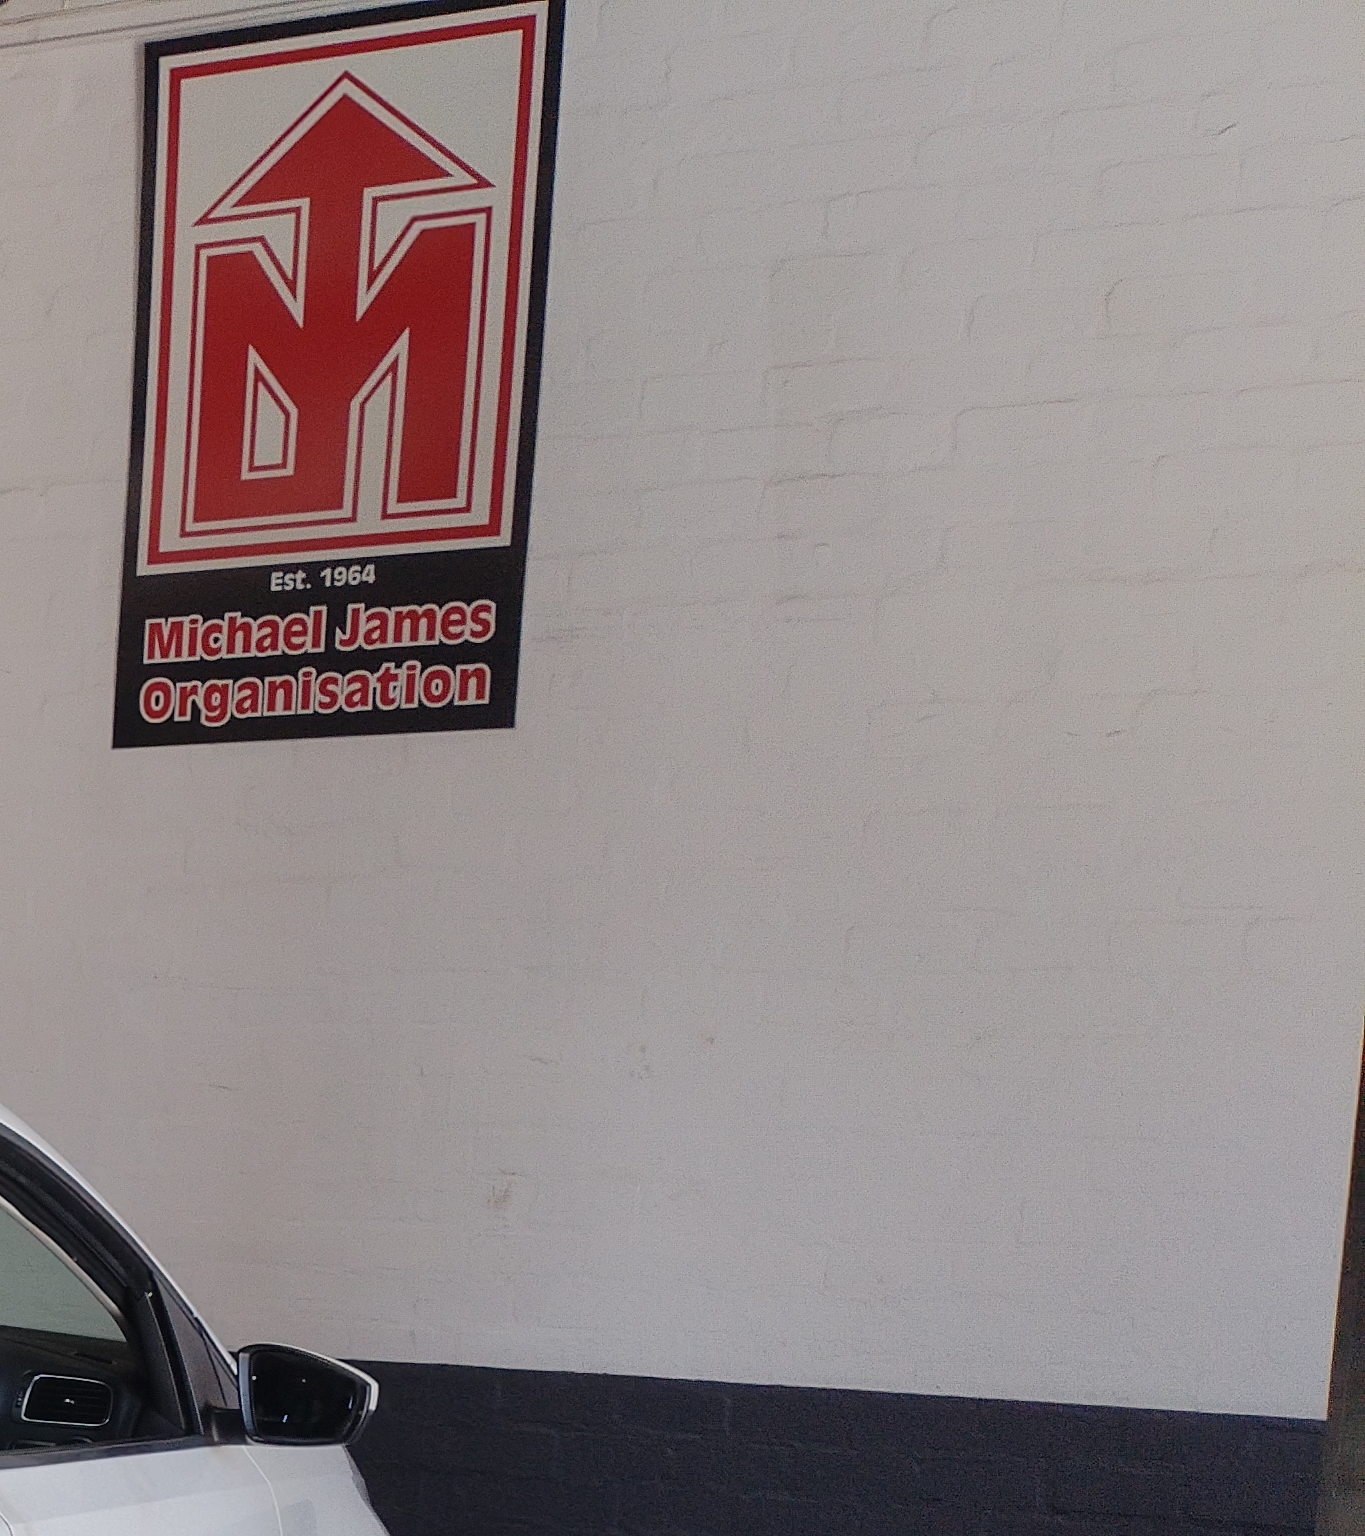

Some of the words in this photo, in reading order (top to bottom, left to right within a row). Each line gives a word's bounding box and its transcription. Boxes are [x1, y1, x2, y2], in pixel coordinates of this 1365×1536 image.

[270, 570, 311, 592] Est.
[320, 564, 376, 588] 1964
[143, 604, 328, 664] Michael
[335, 599, 496, 651] James
[139, 660, 491, 728] Organisation
